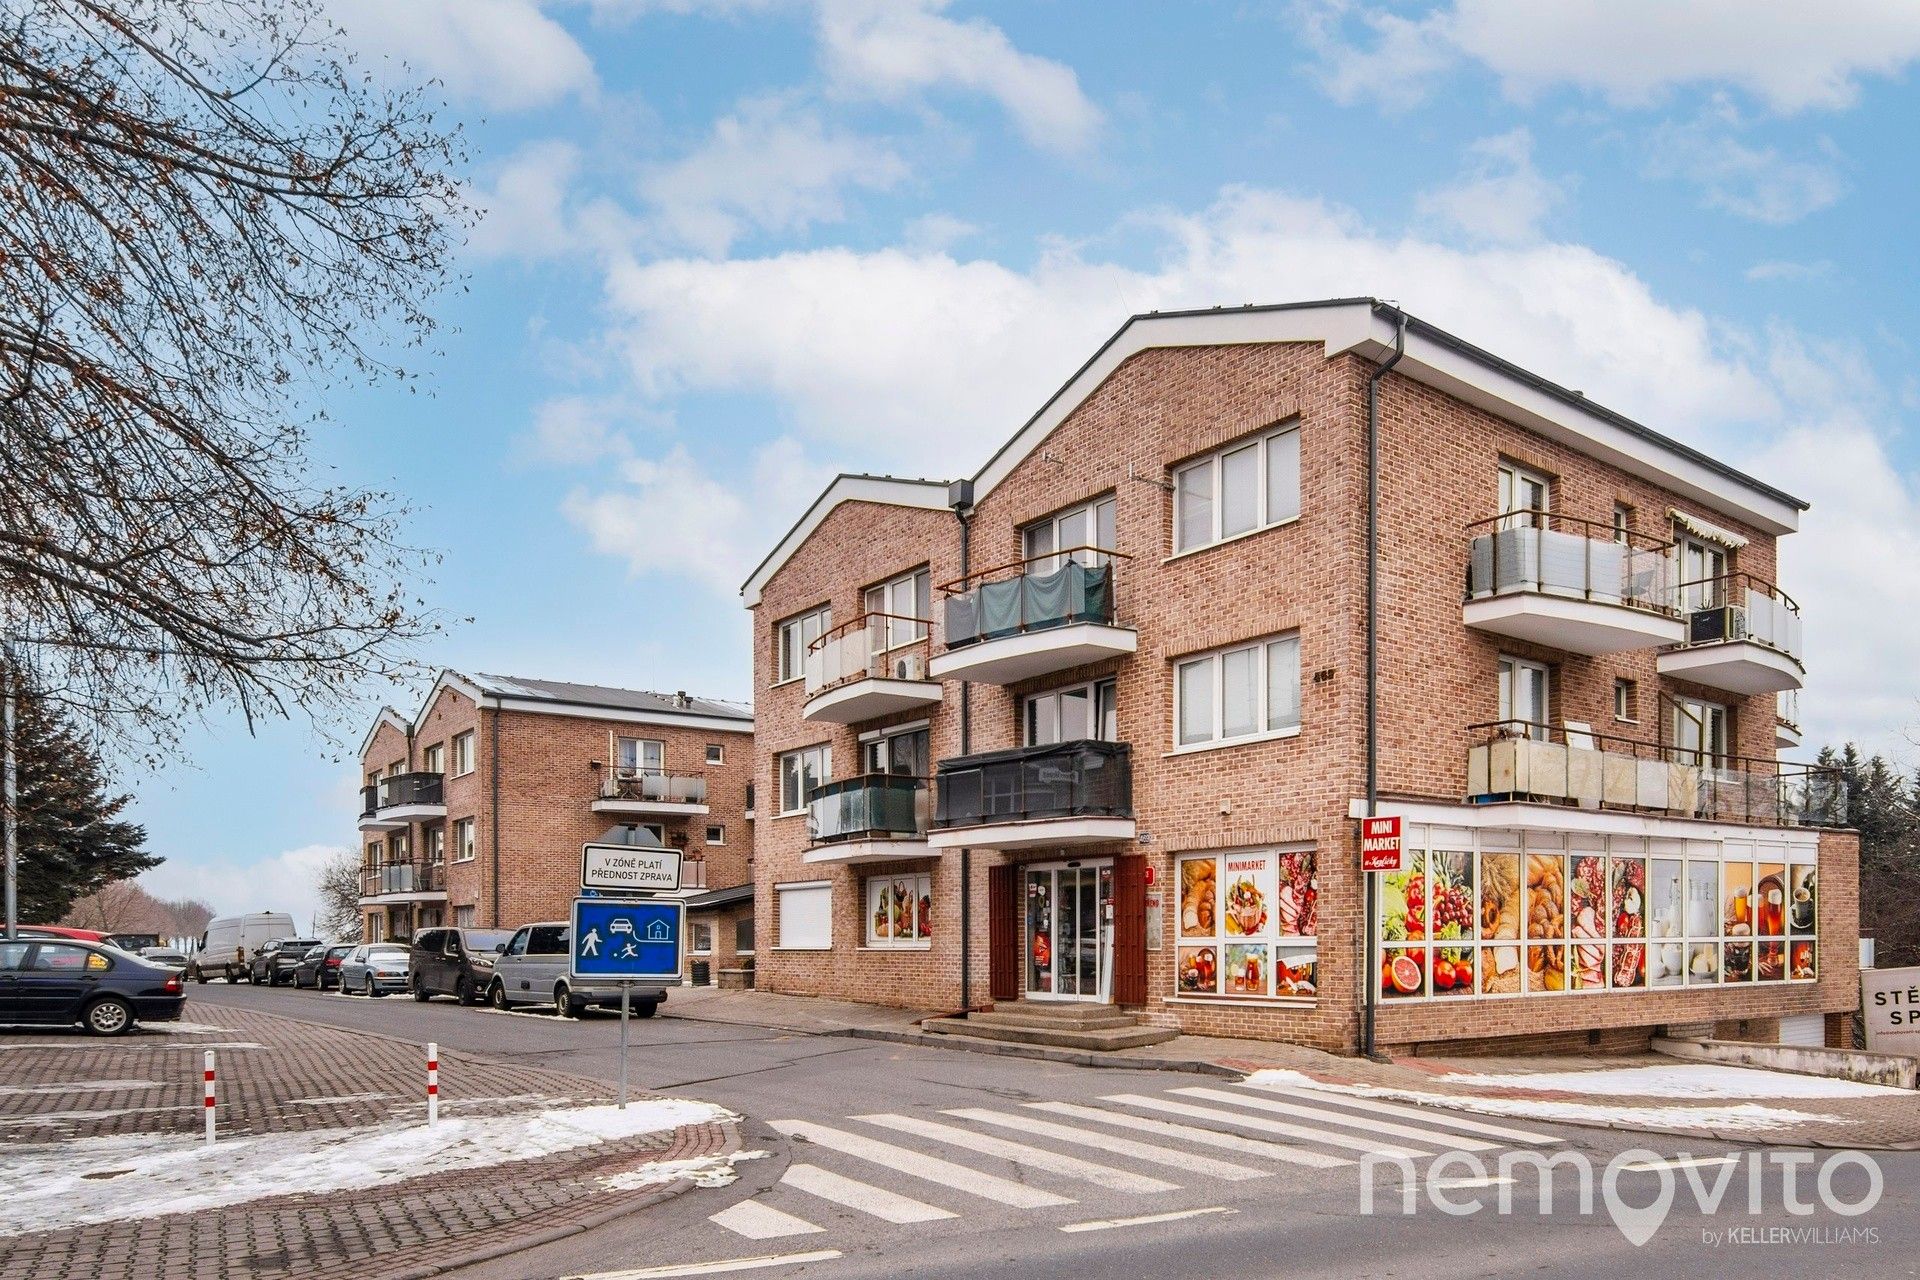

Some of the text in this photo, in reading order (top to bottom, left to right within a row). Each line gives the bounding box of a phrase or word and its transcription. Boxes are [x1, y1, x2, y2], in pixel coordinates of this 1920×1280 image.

[1371, 821, 1393, 834] MINI
[1363, 837, 1400, 852] MARKET
[604, 857, 663, 870] V ZÓNĚ PLATÍ
[1228, 860, 1266, 872] MINIMARKET
[591, 868, 673, 882] PŘEDNOST ZPRAVA
[1874, 985, 1920, 1006] STĚ
